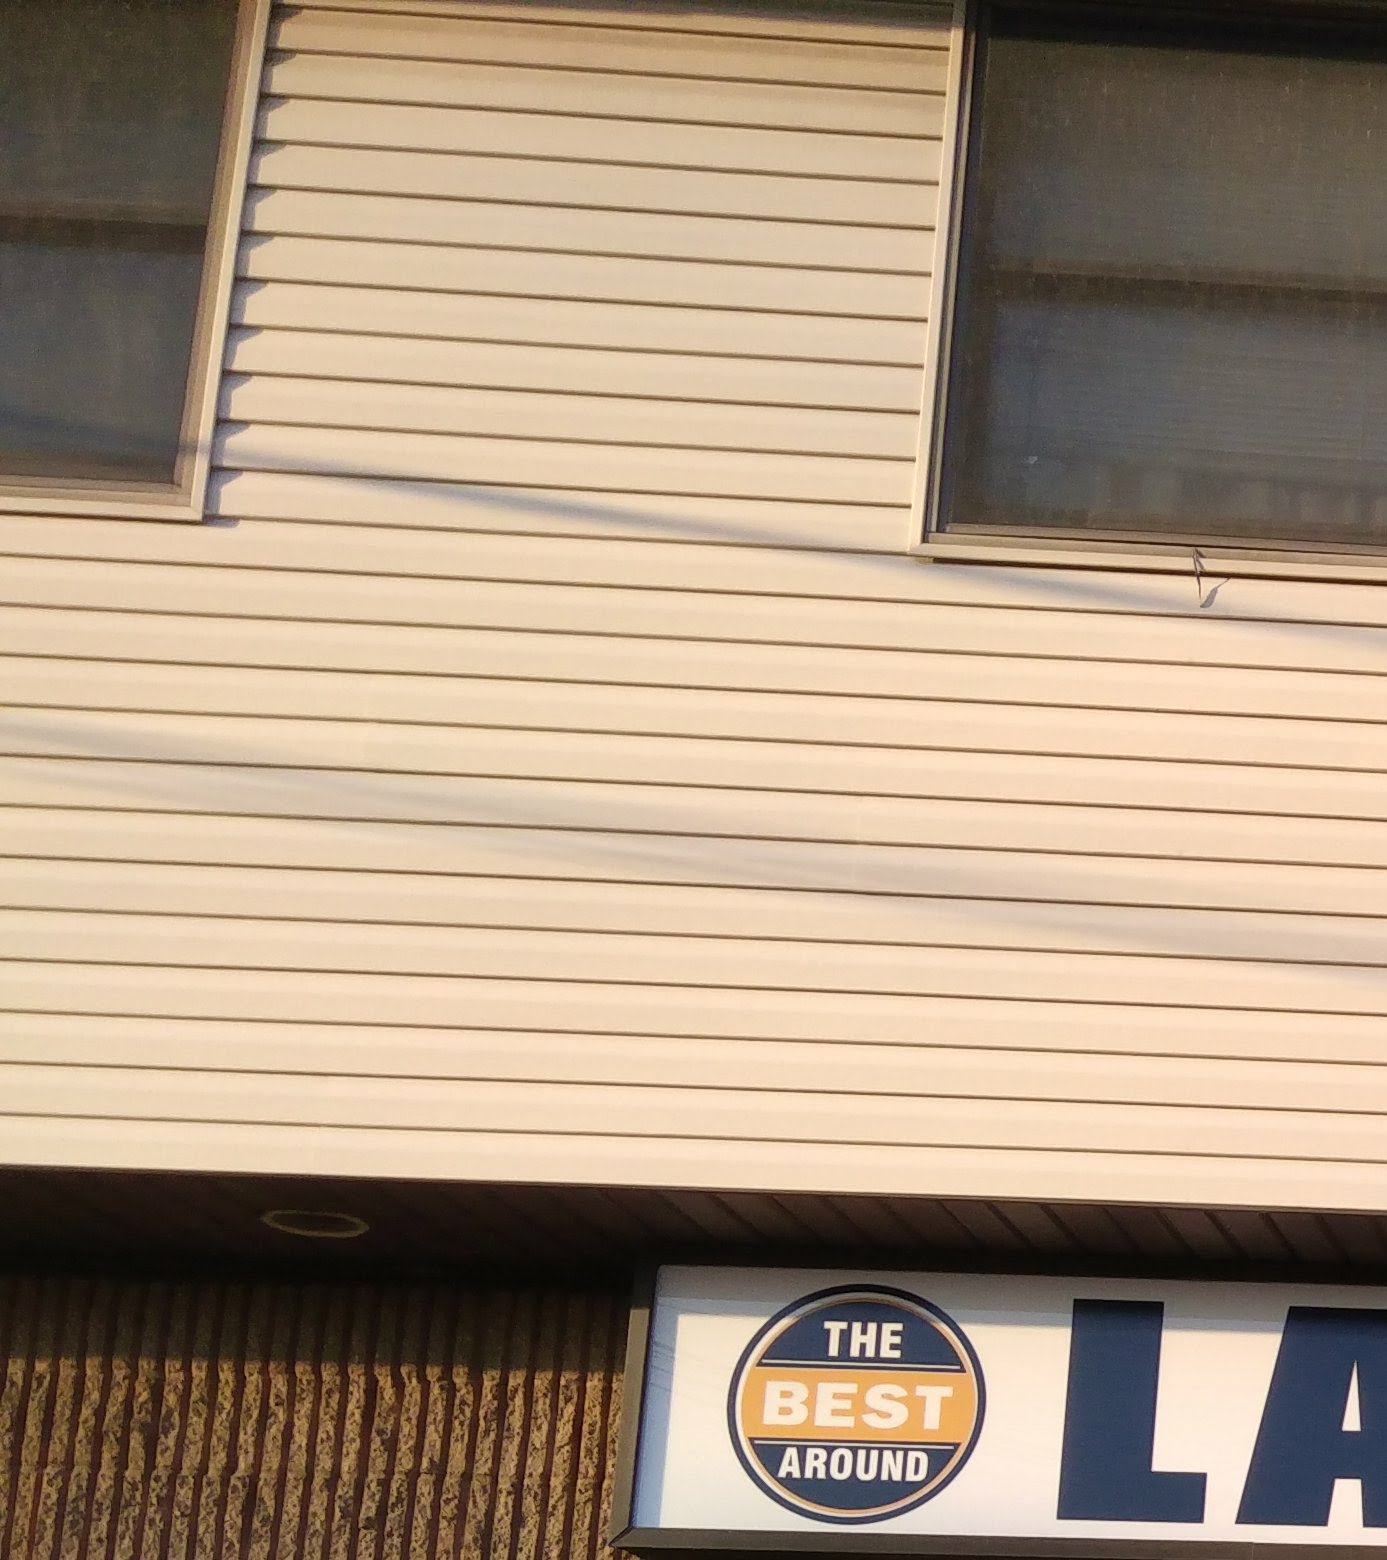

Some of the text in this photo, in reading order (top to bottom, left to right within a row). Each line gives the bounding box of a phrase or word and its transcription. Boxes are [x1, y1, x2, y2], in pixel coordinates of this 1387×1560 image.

[823, 1320, 904, 1359] THE
[763, 1380, 954, 1430] BEST
[777, 1446, 930, 1482] AROUND
